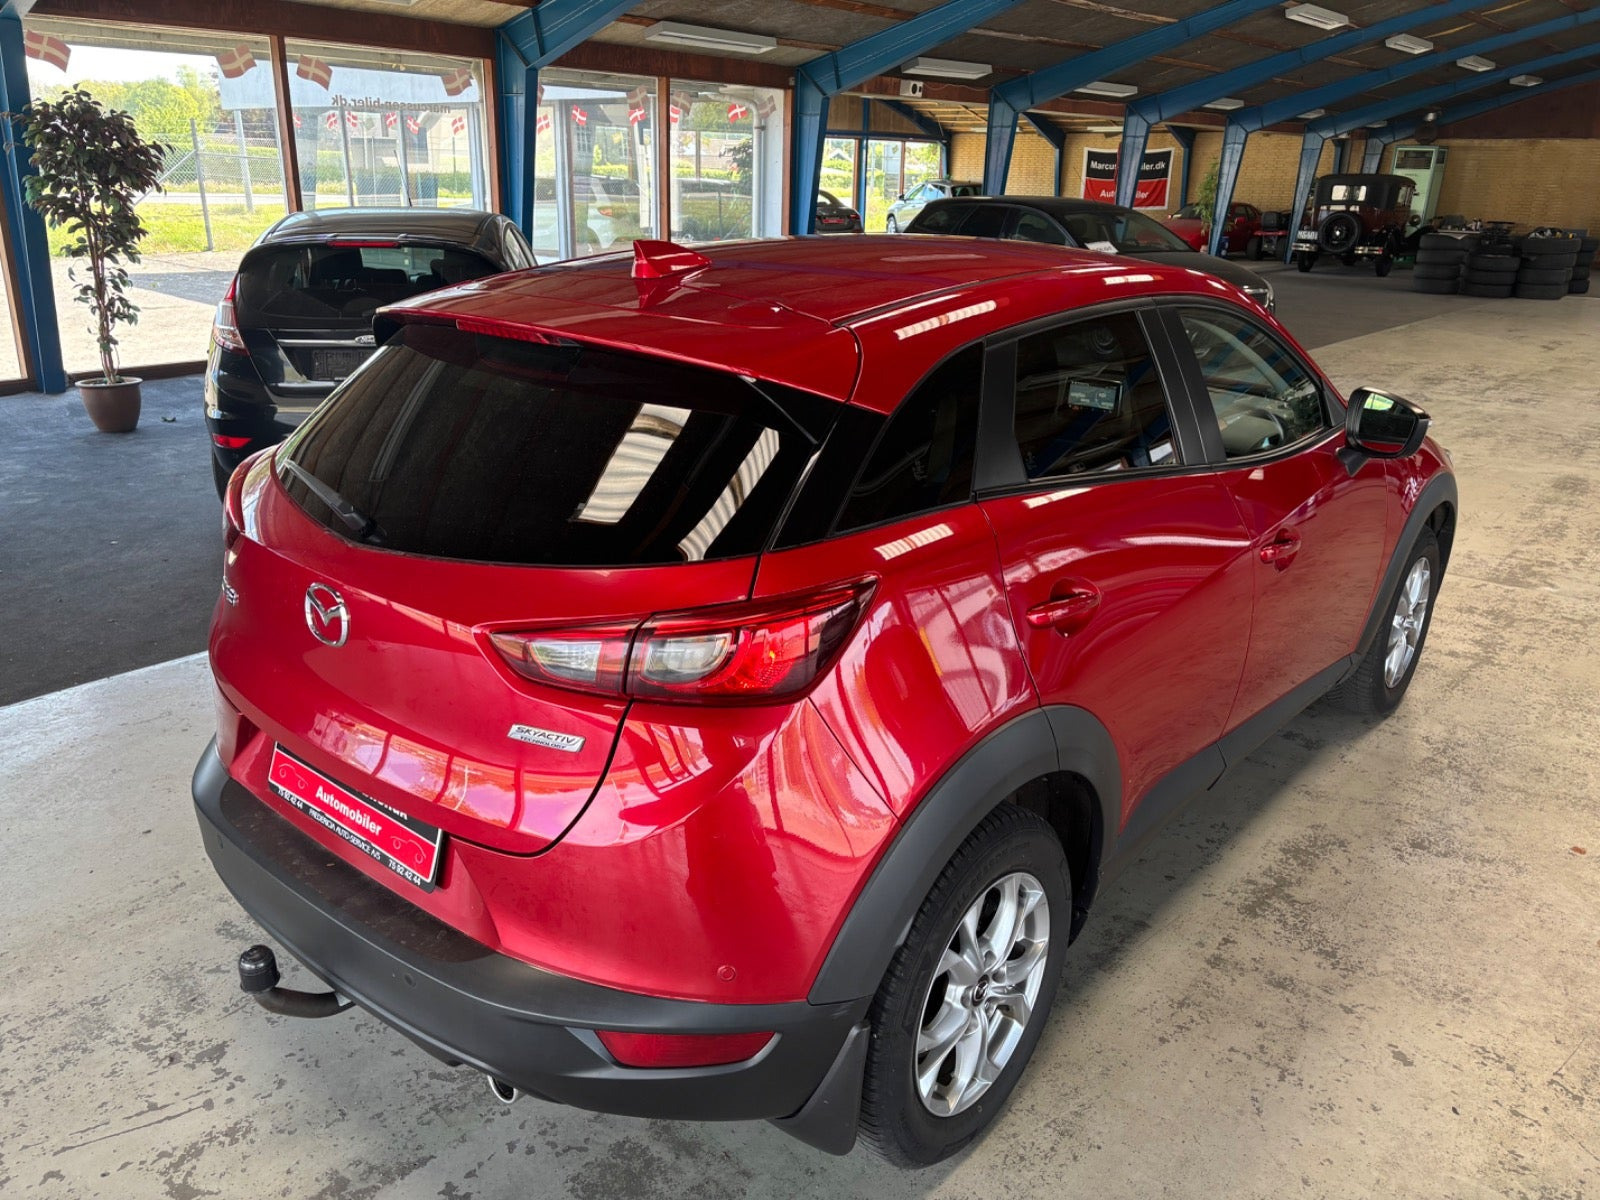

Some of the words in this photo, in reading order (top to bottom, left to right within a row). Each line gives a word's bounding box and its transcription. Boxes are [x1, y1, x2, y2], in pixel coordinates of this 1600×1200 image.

[515, 726, 576, 744] SKYACTIV
[315, 785, 383, 836] Automobiler
[389, 859, 396, 870] 75
[396, 864, 404, 875] 92
[404, 870, 413, 880] 42
[413, 875, 421, 886] 44
